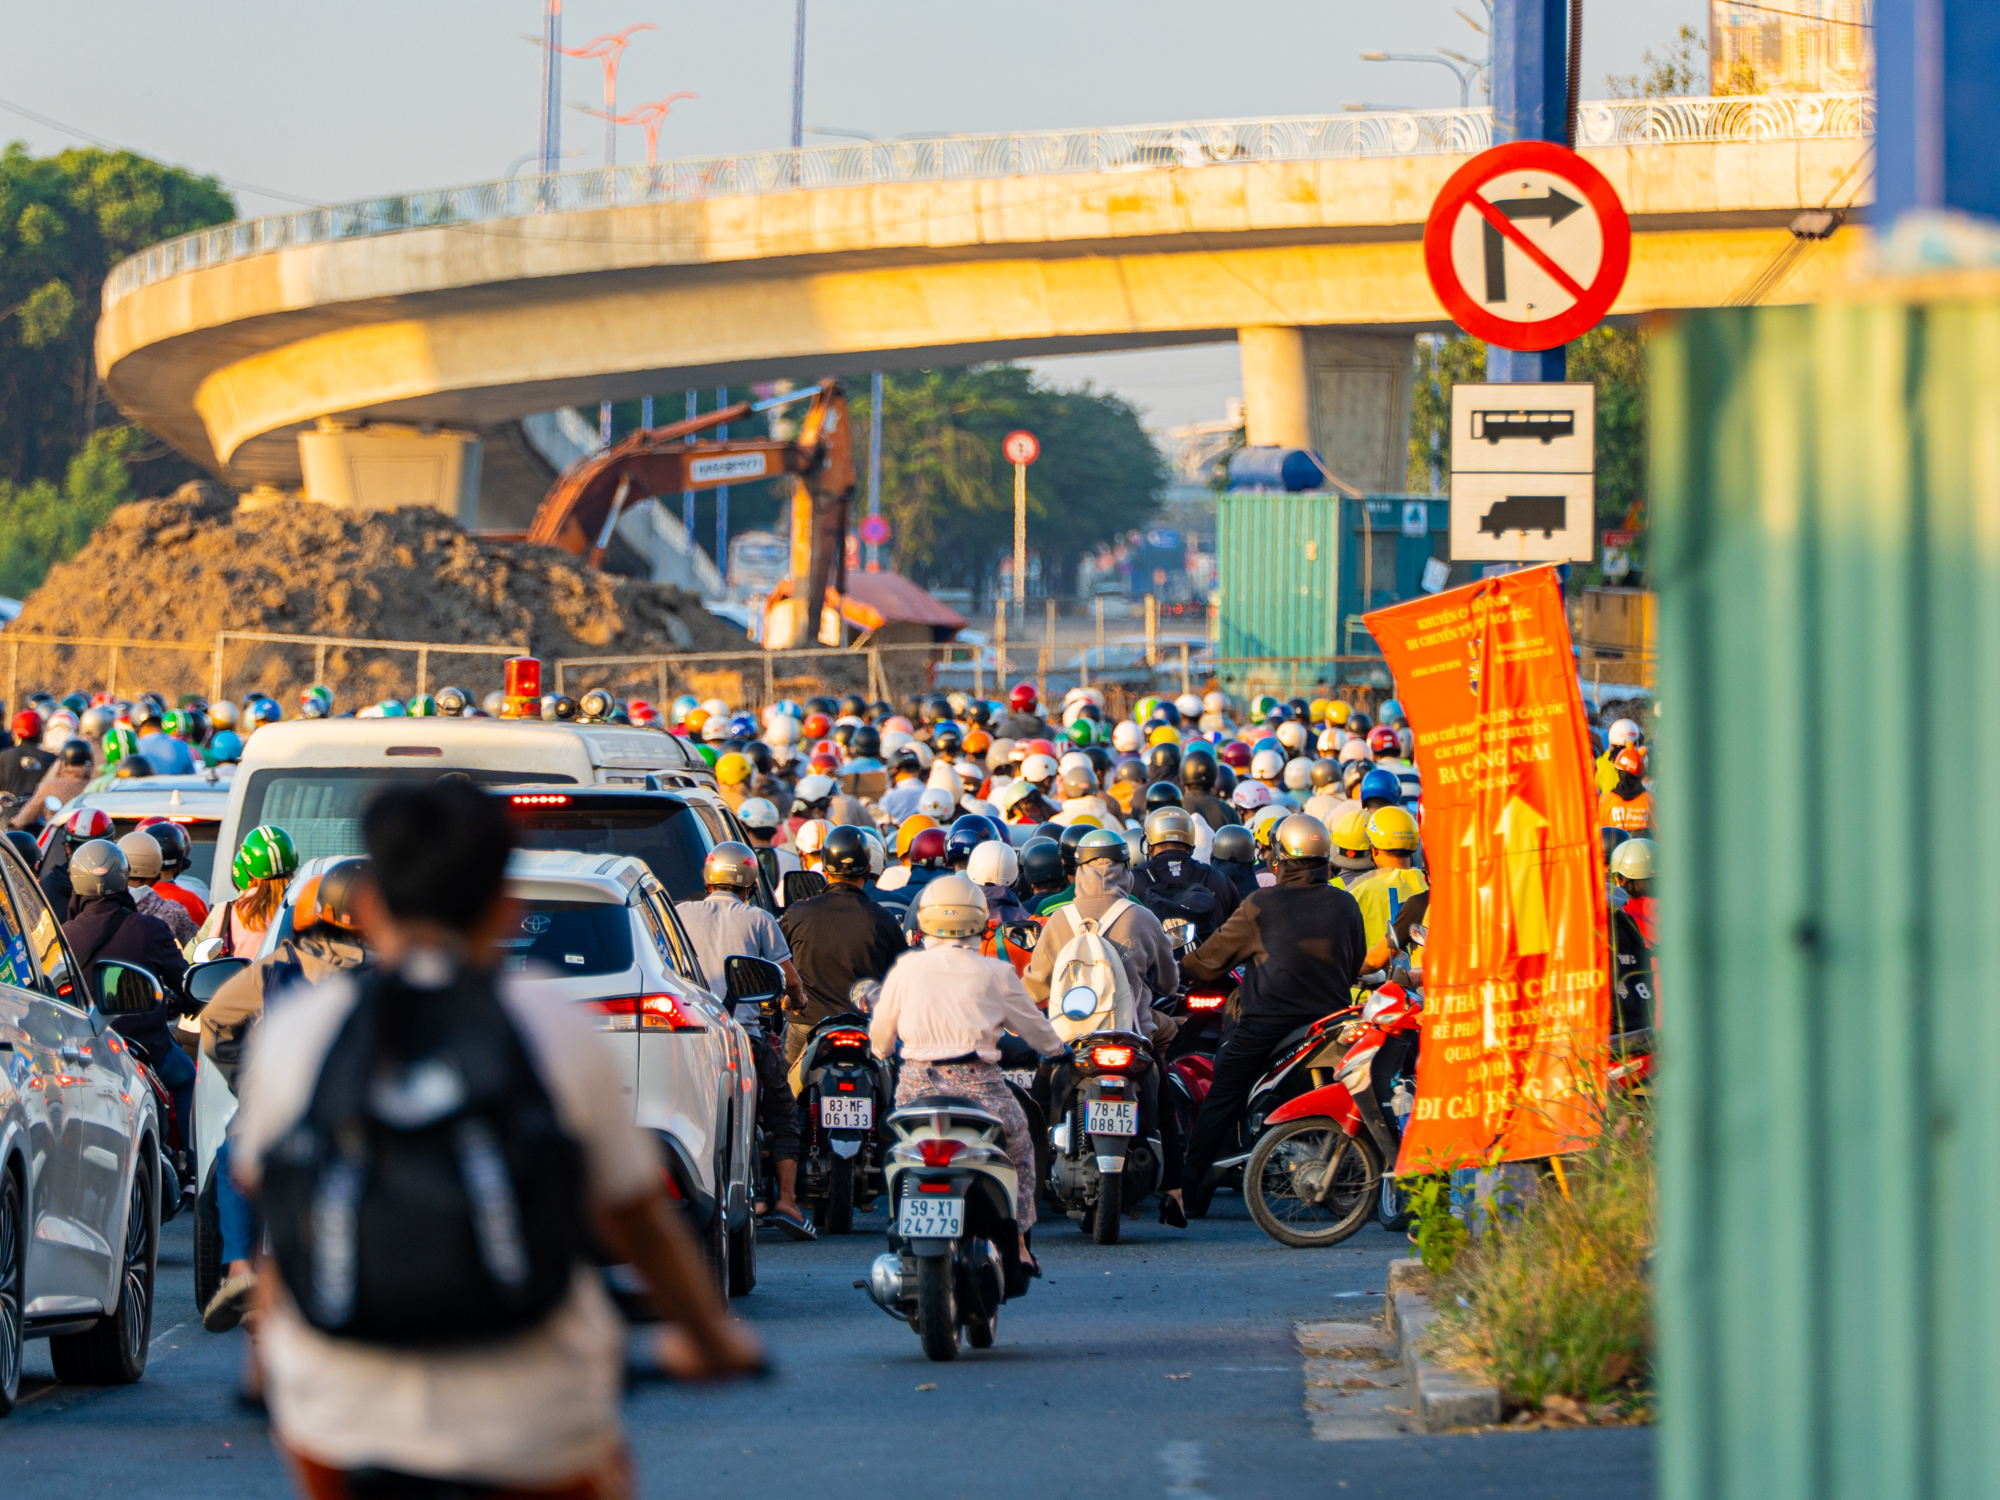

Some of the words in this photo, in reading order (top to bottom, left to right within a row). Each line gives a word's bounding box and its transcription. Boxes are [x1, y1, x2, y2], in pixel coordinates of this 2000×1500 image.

[1417, 609, 1458, 630] KHUYẾN
[1406, 637, 1419, 650] DI
[1419, 625, 1458, 648] CHUYỂN
[1418, 732, 1438, 746] HẠN
[1439, 725, 1458, 742] CHẾ
[1517, 706, 1543, 720] CAO
[1438, 766, 1460, 785] RA
[1511, 743, 1551, 764] NAI
[1424, 997, 1440, 1016] ĐI
[1564, 969, 1605, 991] THỌ
[1635, 982, 1651, 999] 8
[1431, 1022, 1450, 1040] RẼ
[830, 1100, 863, 1112] 83-MF
[1094, 1102, 1130, 1118] 78-AE
[1415, 1097, 1442, 1120] ĐI
[825, 1113, 869, 1128] 061.33
[1090, 1118, 1134, 1134] 088.12
[910, 1200, 953, 1217] 59-X1
[904, 1218, 960, 1236] 247.79
